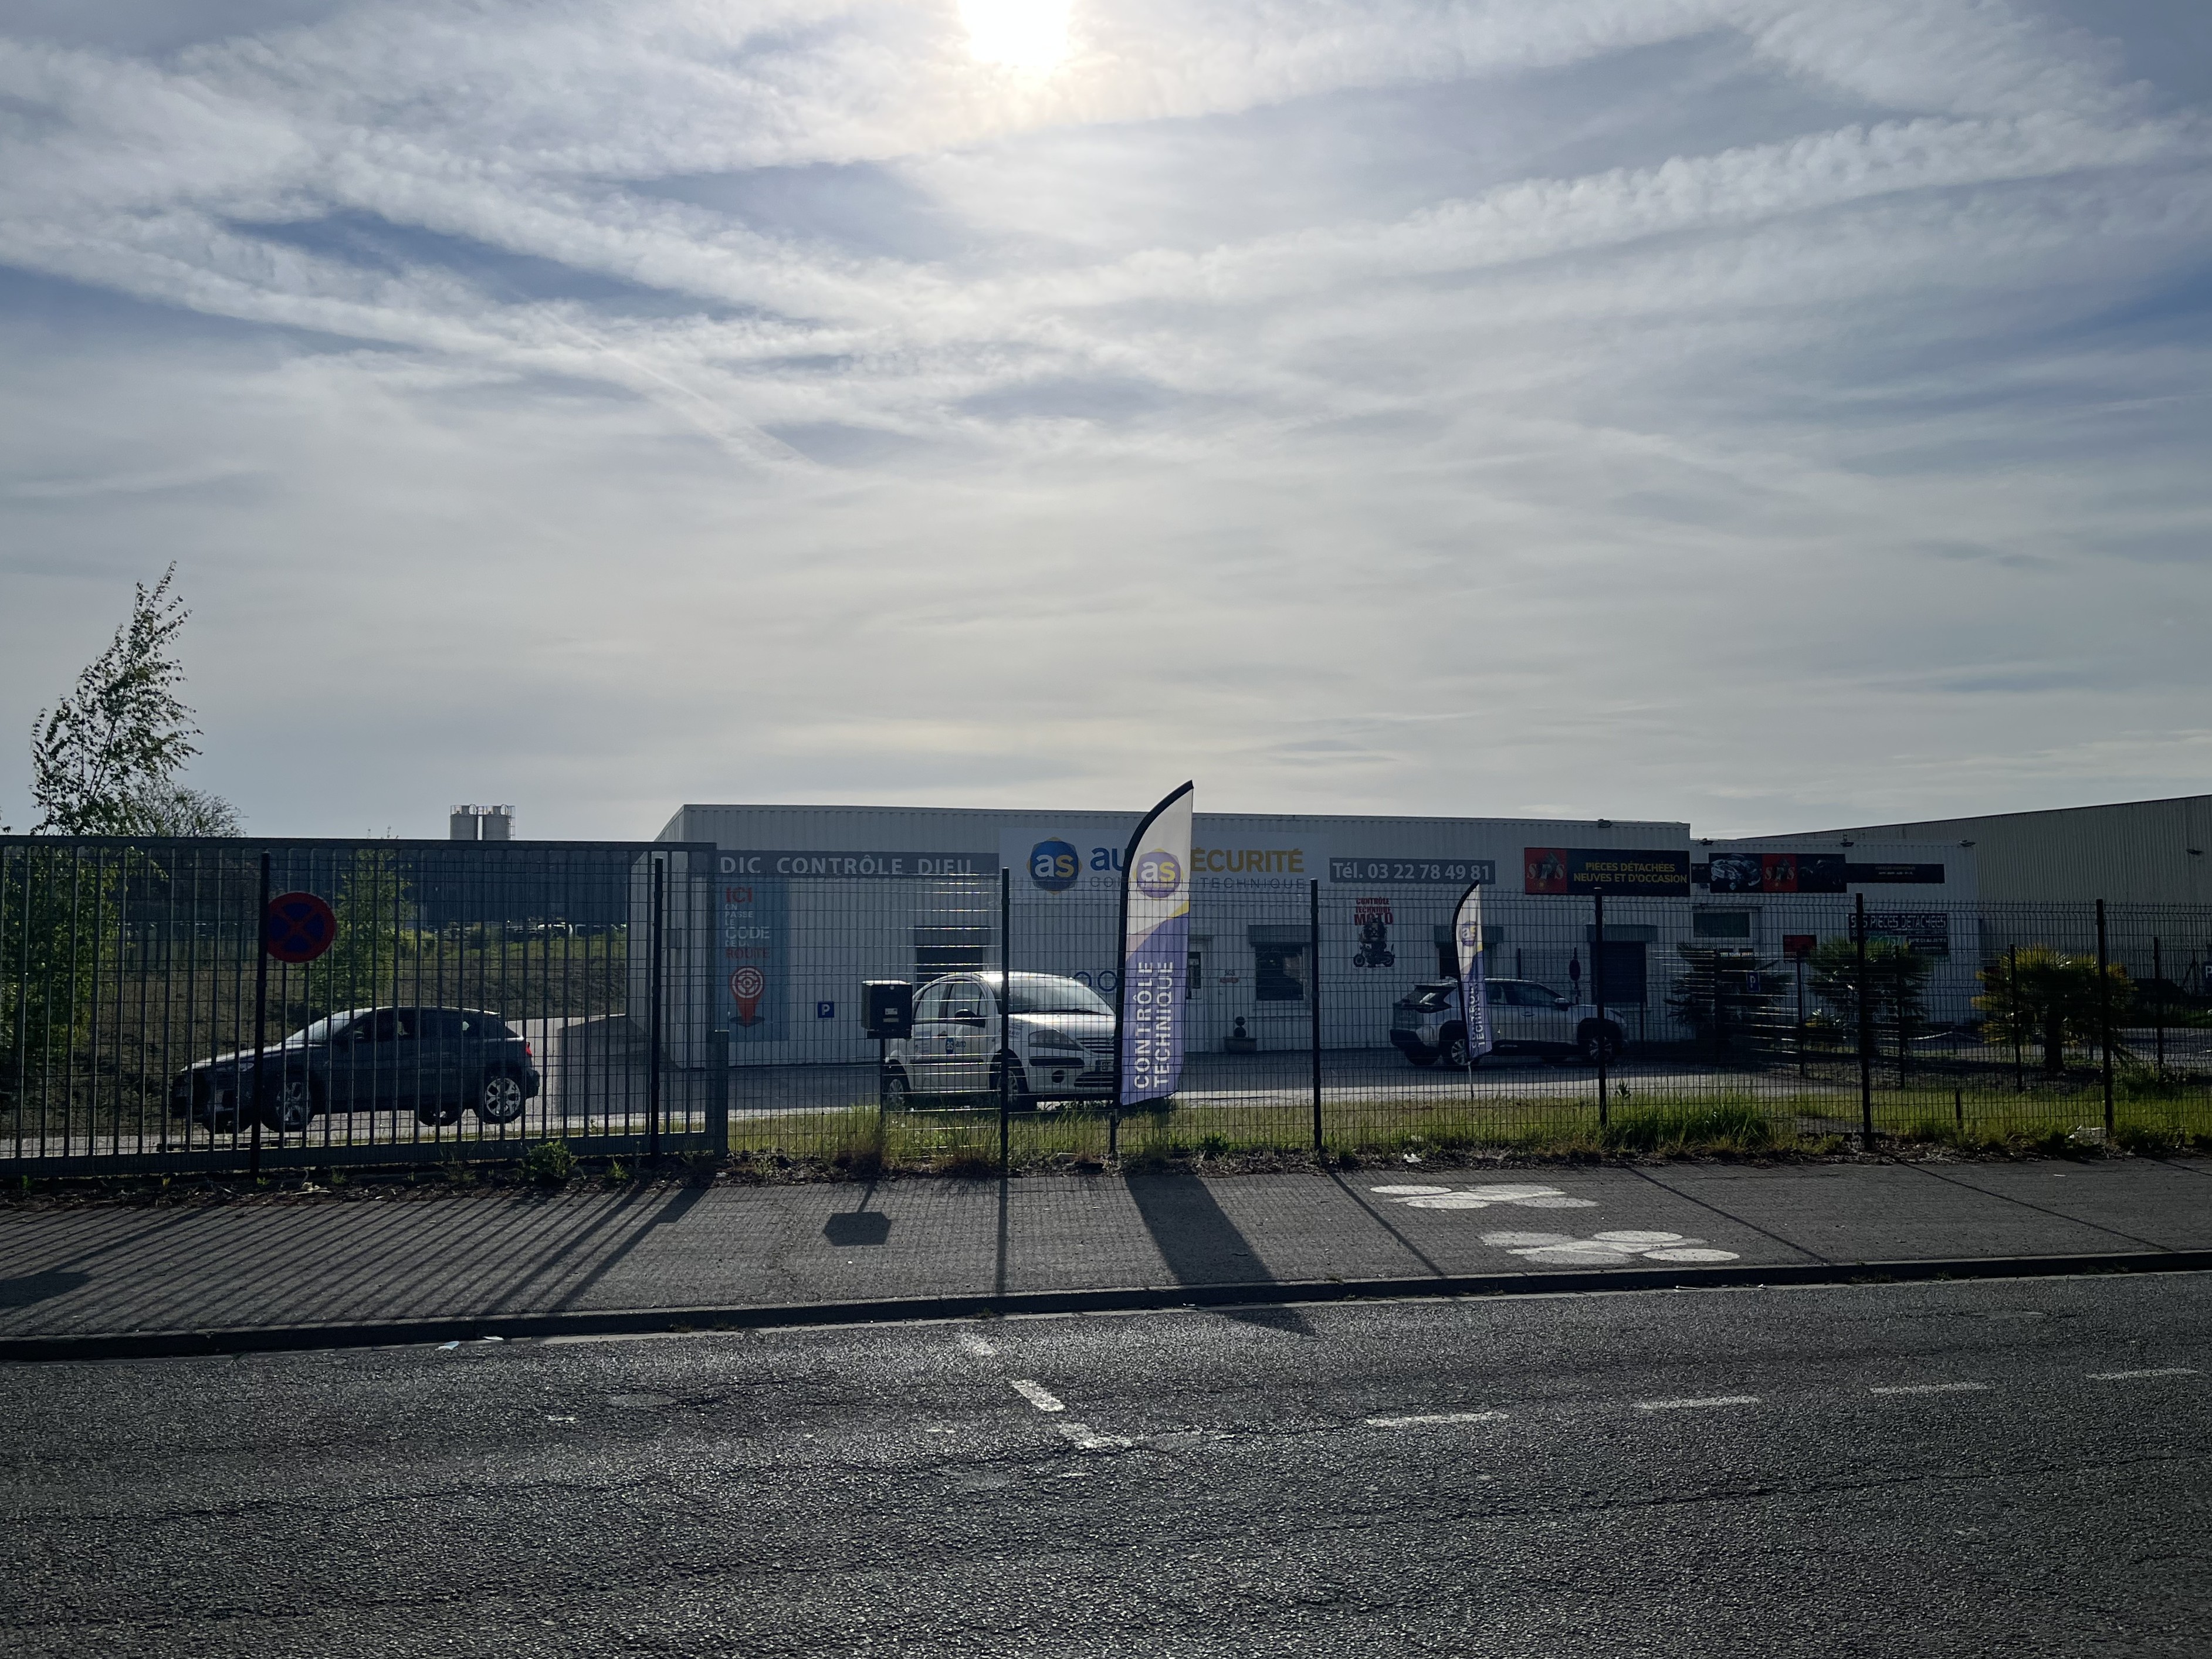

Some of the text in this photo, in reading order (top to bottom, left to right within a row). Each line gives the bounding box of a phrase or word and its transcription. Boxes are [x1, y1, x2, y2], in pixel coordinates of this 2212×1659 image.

[720, 854, 971, 875] DIC CONTRÔLE DIEU
[1034, 854, 1075, 878] as
[1191, 847, 1305, 873] ÉCURITÉ
[1140, 861, 1176, 882] as
[1332, 861, 1489, 881] Tél. 03 22 78 49 81
[1573, 872, 1688, 883] NEUVES ET D'OCCASION
[1200, 877, 1305, 889] TECHNIQUE
[726, 886, 753, 903] ICI
[1850, 915, 1868, 928] SS
[725, 926, 770, 939] CODE
[821, 1003, 831, 1015] P
[1133, 961, 1153, 1089] CONTRÔLE
[1153, 961, 1173, 1088] TECHNIQUE
